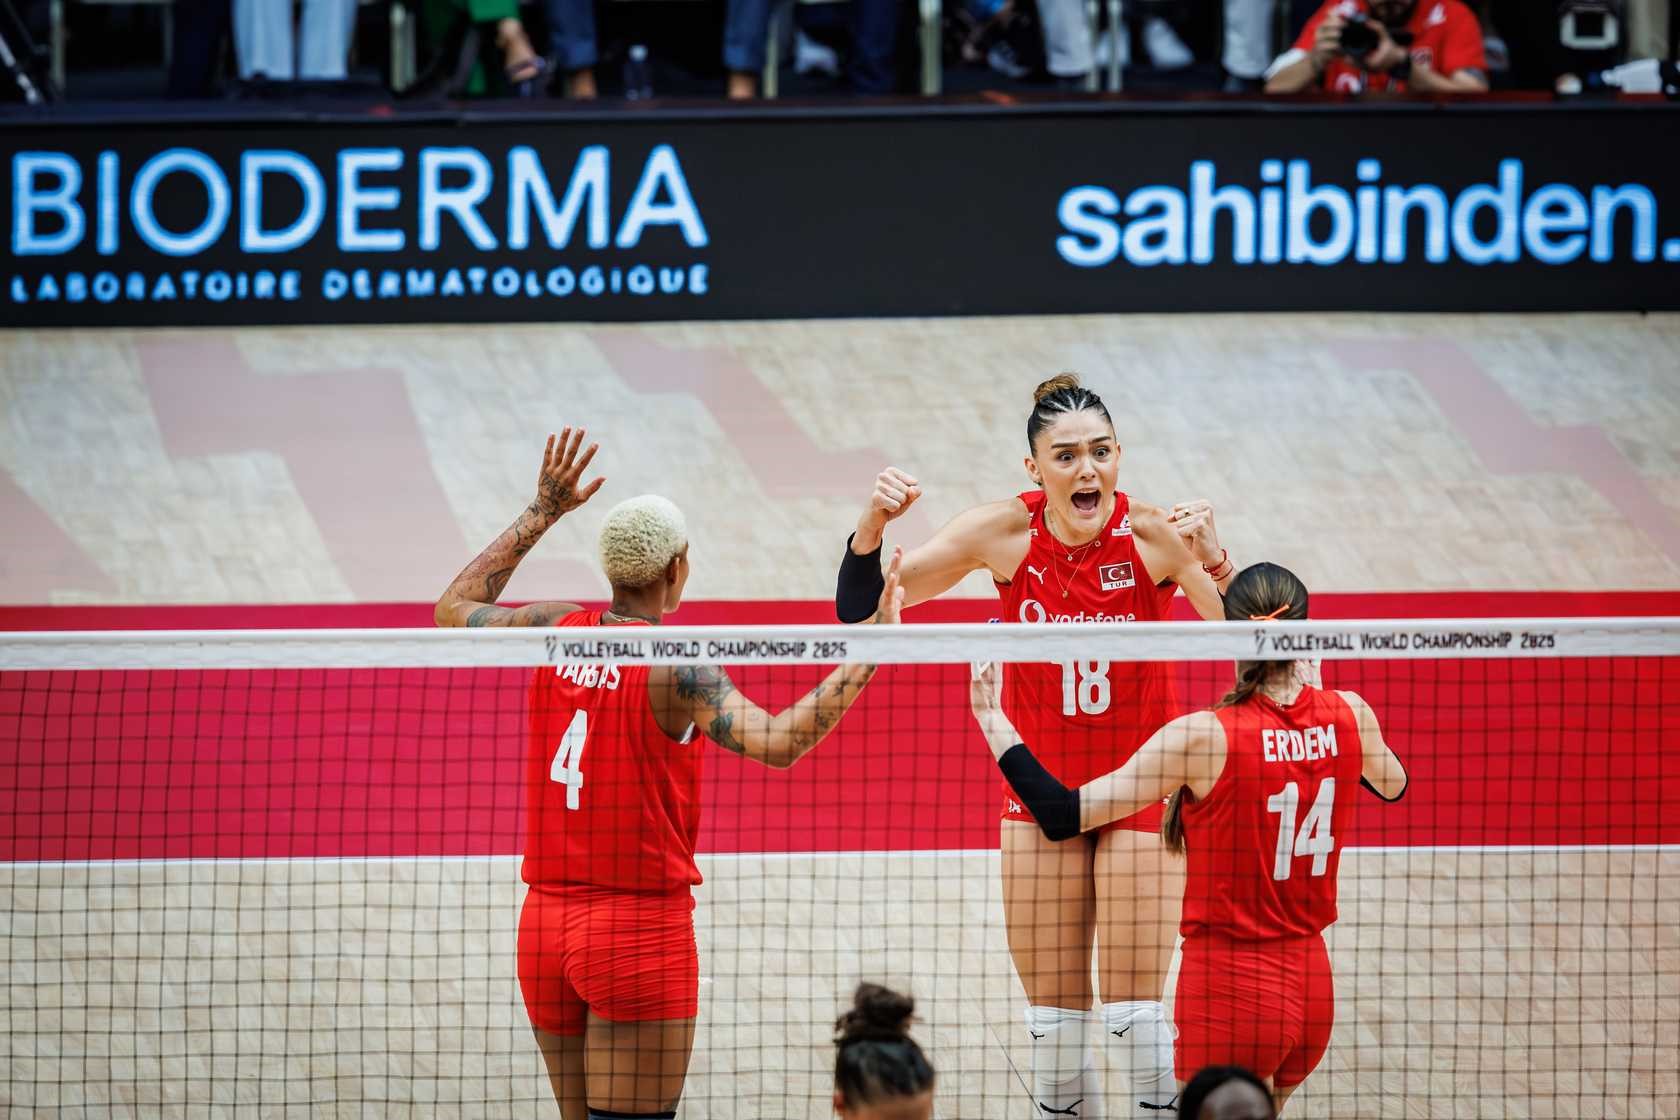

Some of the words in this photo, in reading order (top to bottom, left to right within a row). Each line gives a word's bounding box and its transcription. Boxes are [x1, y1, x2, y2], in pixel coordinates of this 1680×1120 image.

[11, 144, 710, 256] BIODERMA
[11, 270, 301, 303] LABORATOIRE
[322, 263, 710, 300] DERMATOLOGIQUE
[1109, 580, 1128, 589] TUR
[563, 641, 644, 659] VOLLEYBALL
[651, 640, 700, 658] WORLD
[707, 640, 808, 658] CHAMPIONSHIP
[1271, 633, 1354, 652] VOLLEYBALL
[1360, 632, 1409, 650] WORLD
[1413, 631, 1514, 650] CHAMPIONSHIP
[1051, 661, 1111, 716] 18
[550, 709, 588, 810] 4
[1262, 723, 1338, 762] ERDEM
[1267, 777, 1336, 881] 14
